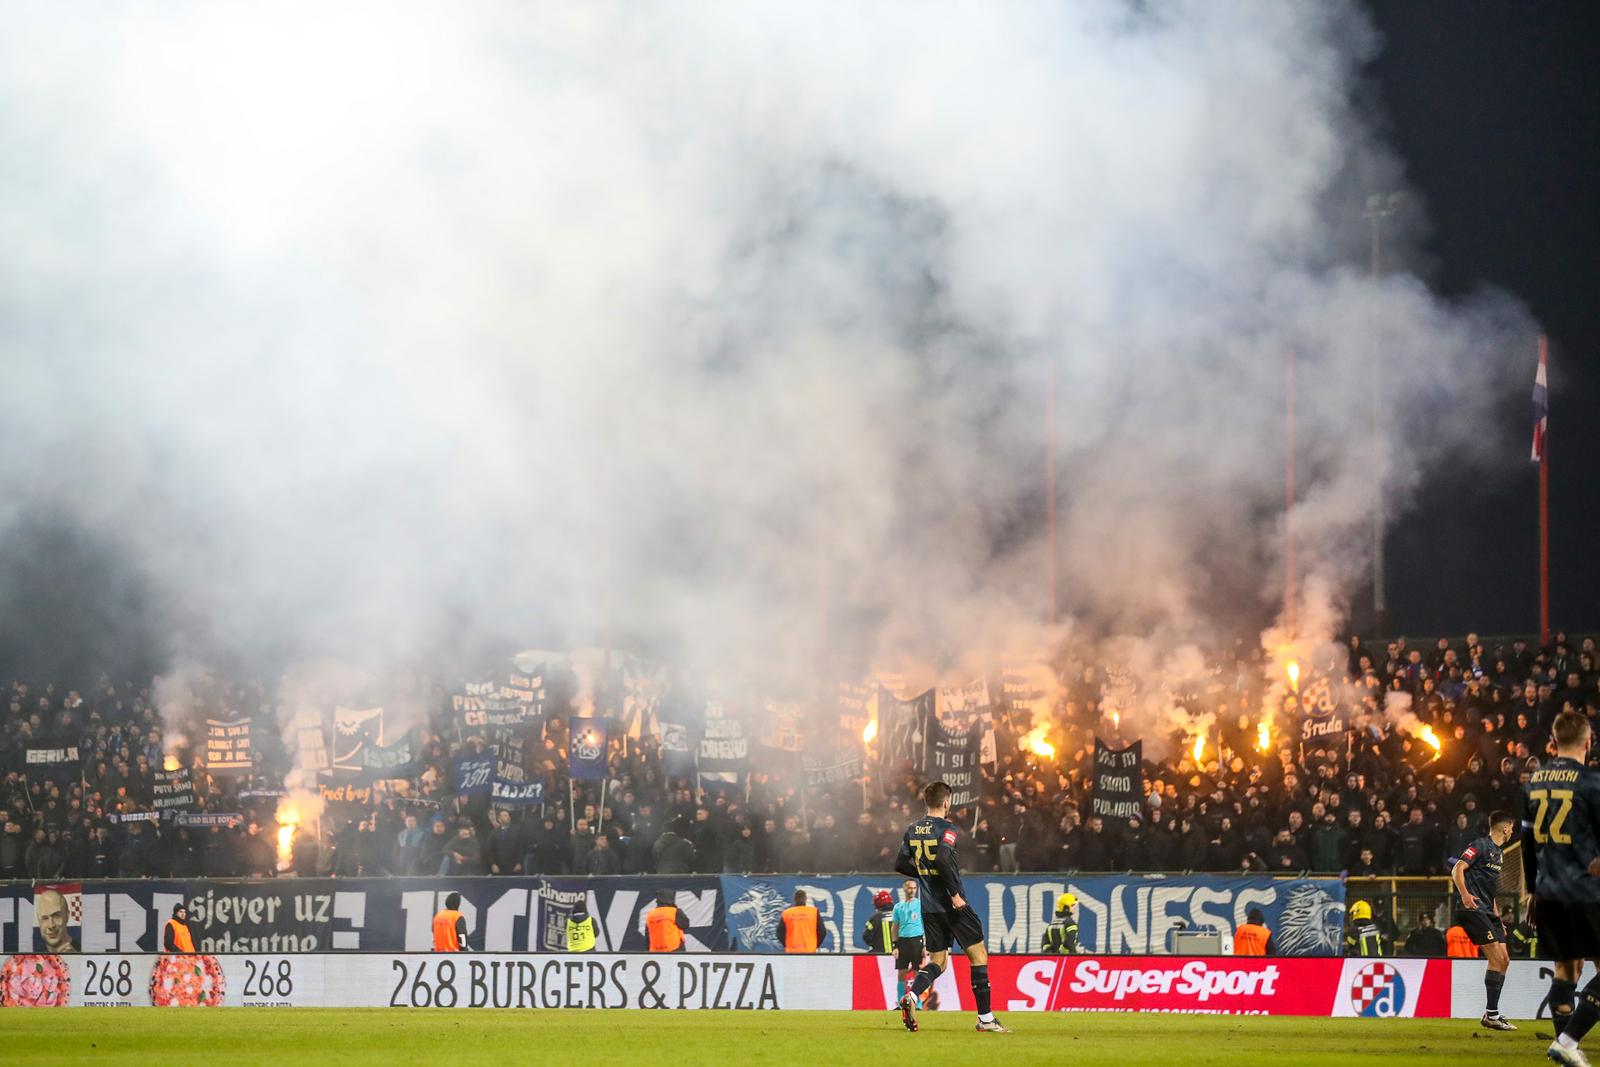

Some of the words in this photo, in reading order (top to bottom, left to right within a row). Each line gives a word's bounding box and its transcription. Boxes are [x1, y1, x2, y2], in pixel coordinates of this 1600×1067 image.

[952, 754, 964, 768] SI
[1530, 789, 1574, 844] 22
[188, 889, 282, 930] sjever
[294, 894, 333, 923] uz
[84, 960, 132, 996] 268
[243, 960, 293, 996] 268
[389, 960, 458, 1008] 268
[468, 960, 628, 1009] BURGERS
[638, 960, 670, 1009] &
[677, 962, 781, 1010] PIZZA
[1070, 960, 1280, 1002] SuperSport
